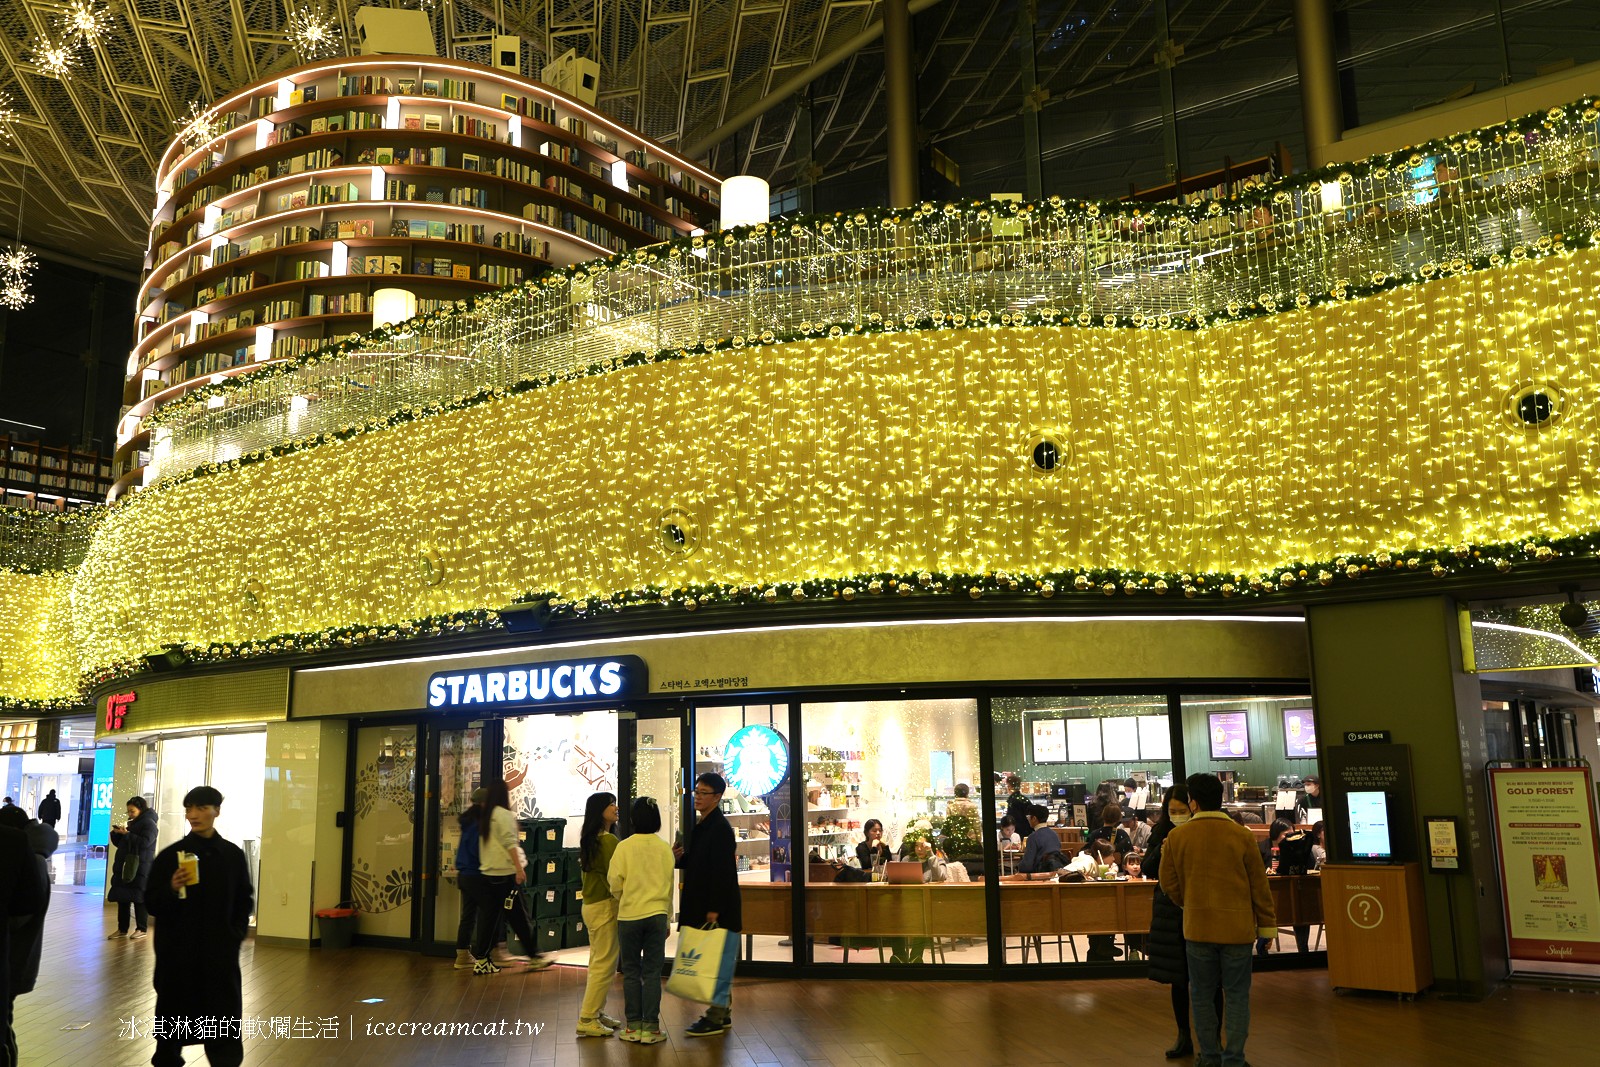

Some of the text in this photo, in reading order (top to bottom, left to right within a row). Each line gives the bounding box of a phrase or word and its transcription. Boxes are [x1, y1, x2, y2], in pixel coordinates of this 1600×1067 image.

[429, 661, 621, 707] STARBUCKS
[660, 676, 748, 690] 스타벅스 코엑스별마당점
[1536, 787, 1574, 795] FOREST
